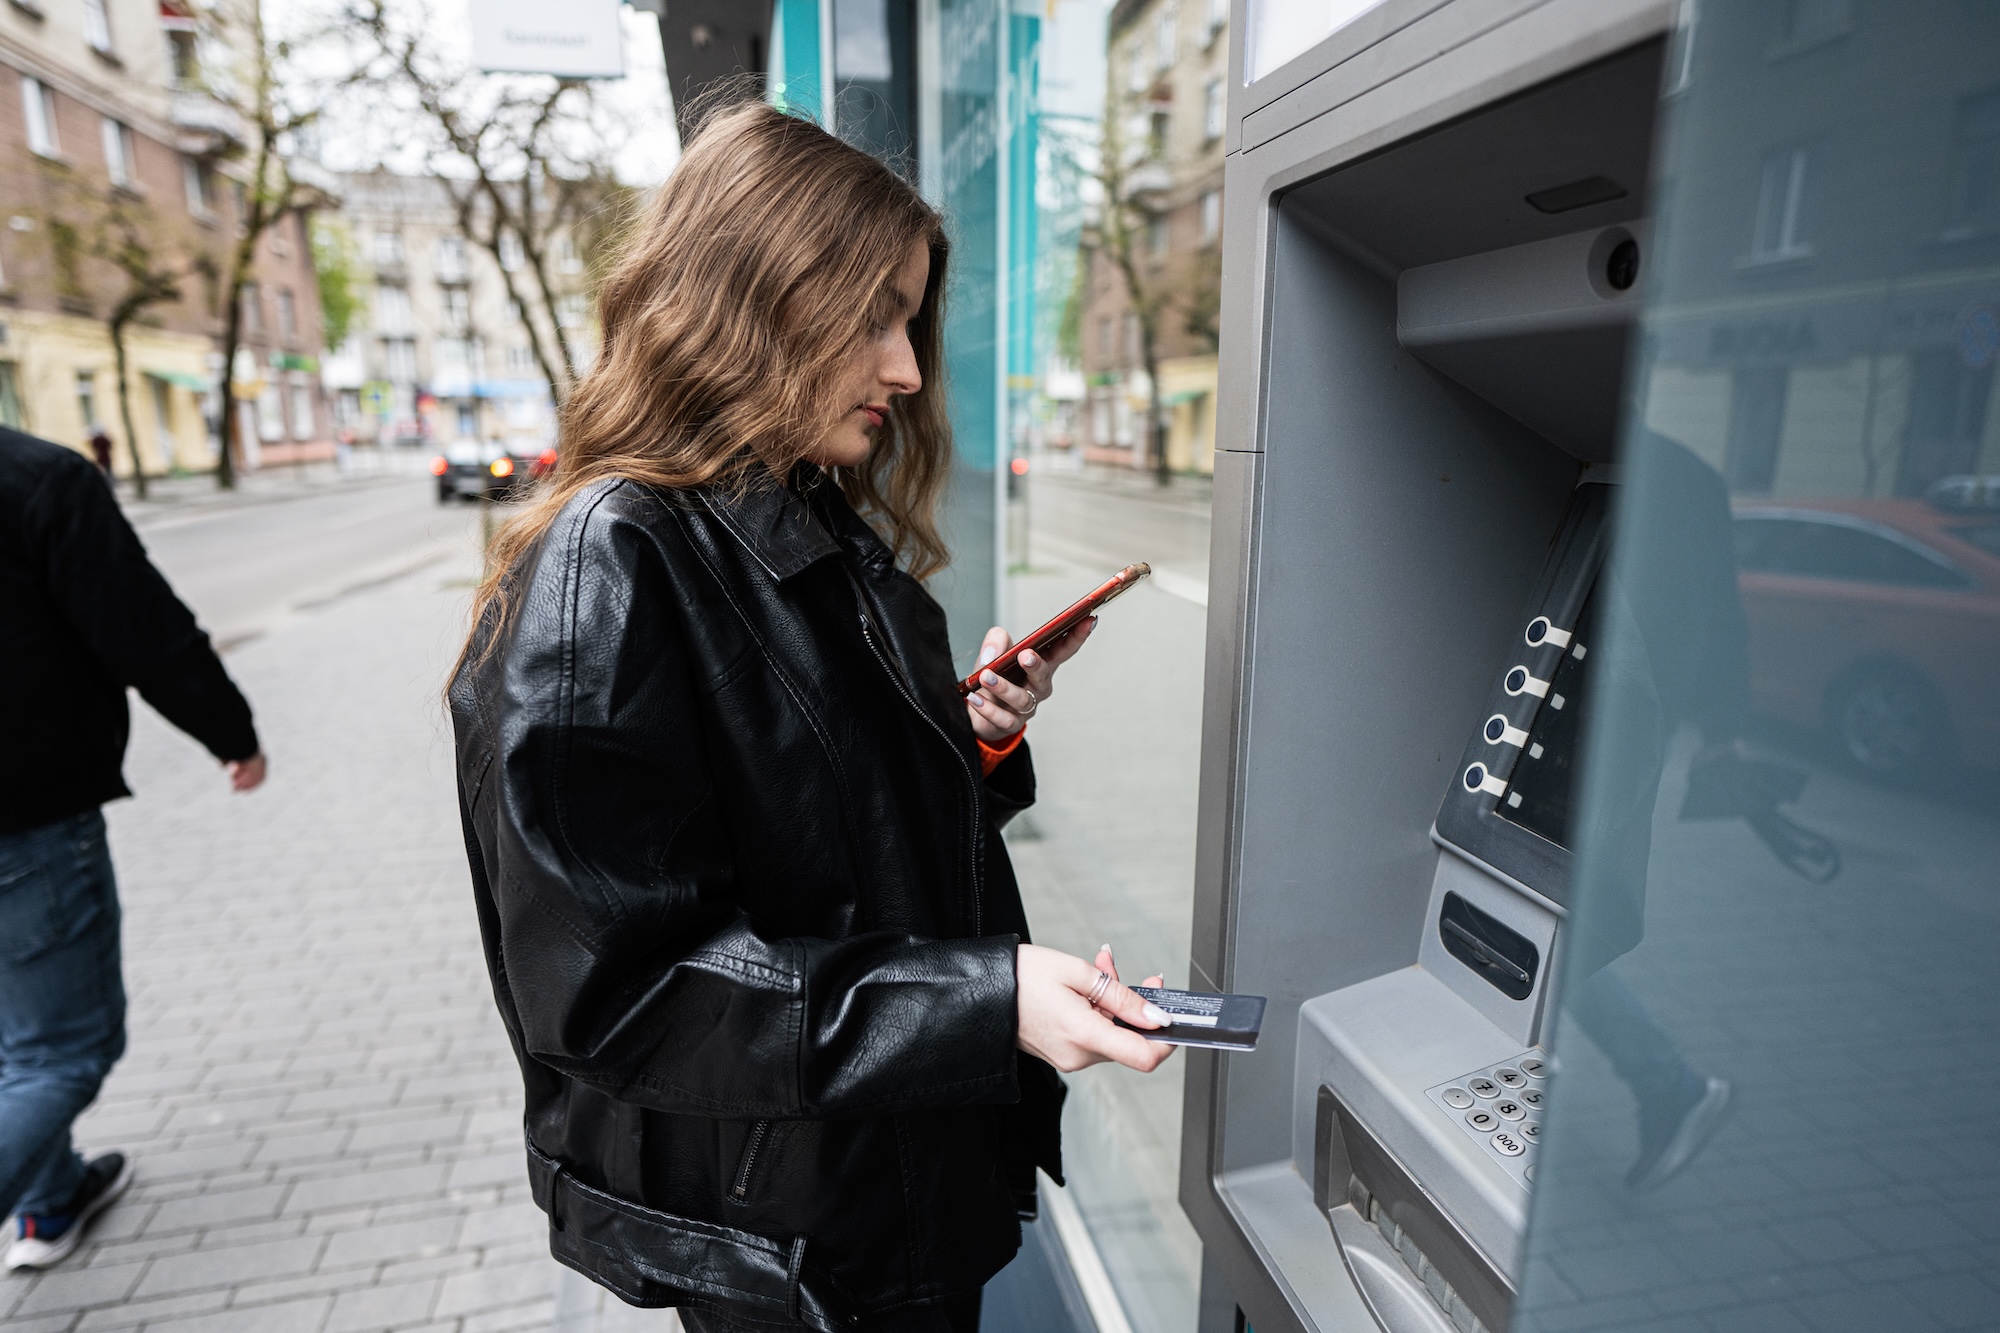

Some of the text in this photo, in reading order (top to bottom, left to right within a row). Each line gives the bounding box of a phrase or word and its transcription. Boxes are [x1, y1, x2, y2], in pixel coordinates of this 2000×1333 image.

[1529, 1063, 1543, 1071] 1
[1503, 1073, 1518, 1083] 4
[1476, 1081, 1493, 1091] 7
[1526, 1094, 1543, 1103] 5
[1500, 1104, 1518, 1114] 8
[1473, 1114, 1490, 1123] 0
[1497, 1134, 1519, 1152] 000
